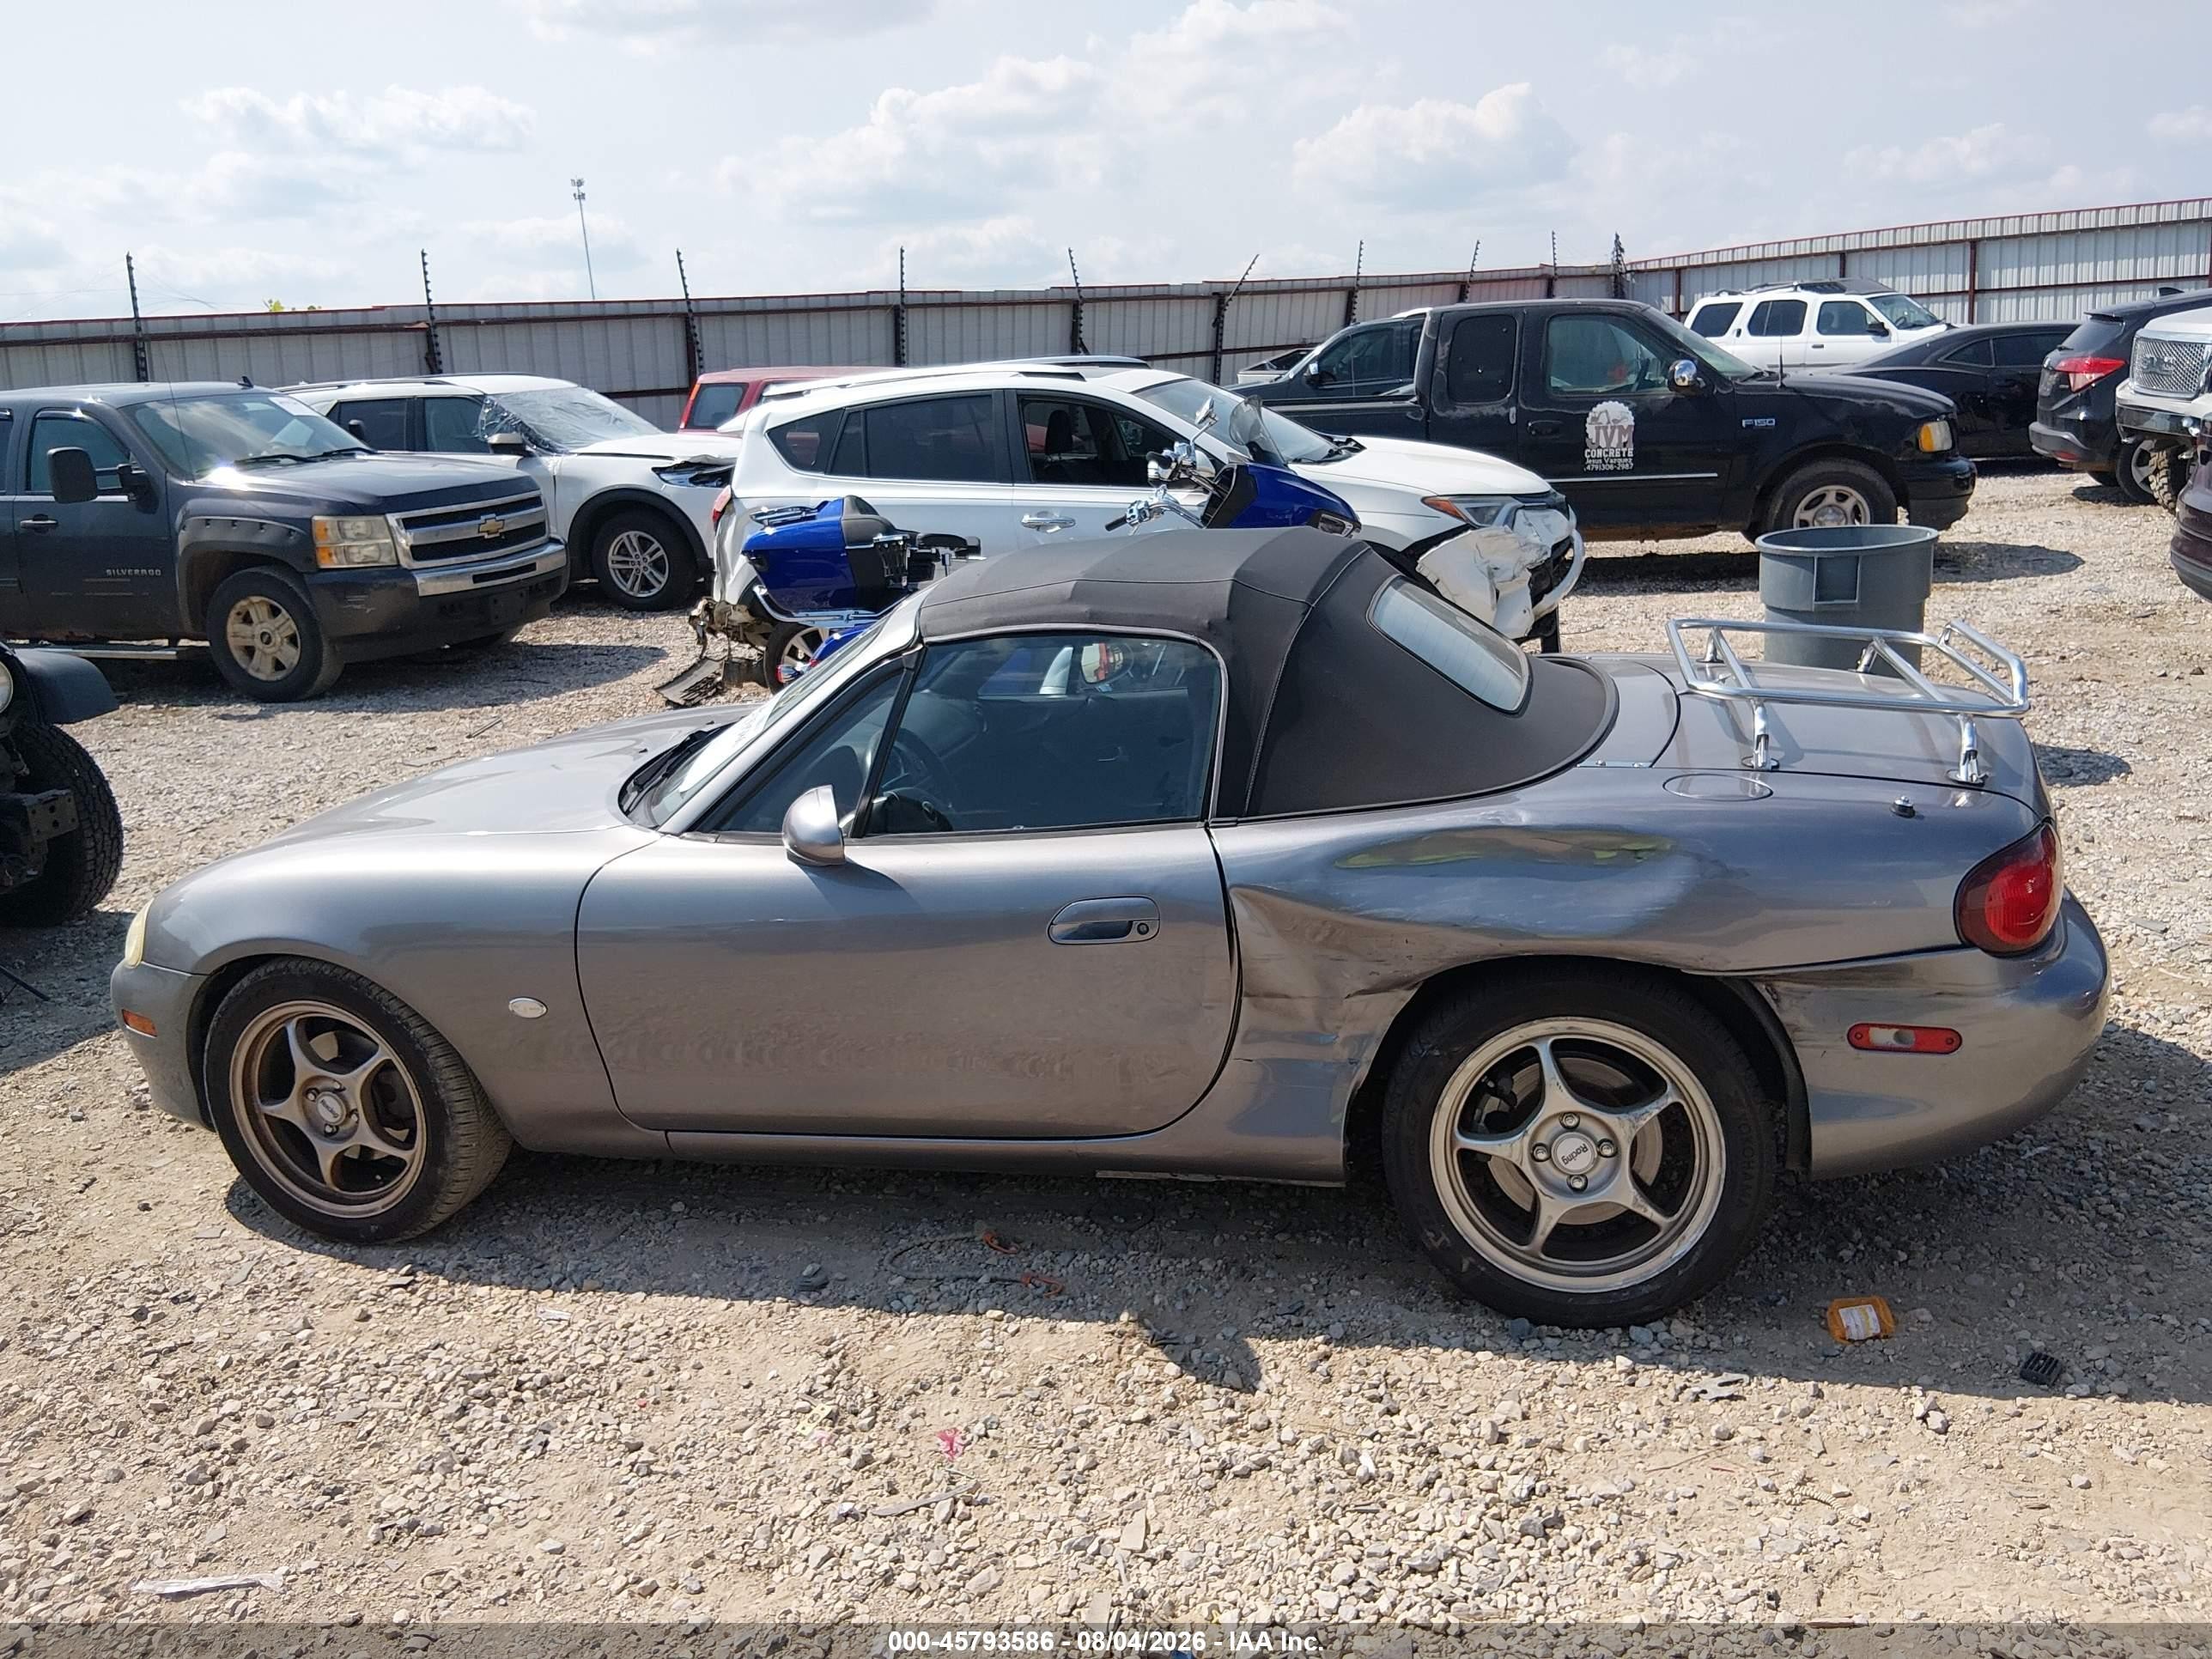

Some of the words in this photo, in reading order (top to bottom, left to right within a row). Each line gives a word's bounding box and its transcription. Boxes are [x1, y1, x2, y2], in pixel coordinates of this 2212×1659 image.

[1741, 418, 1776, 428] F150
[1585, 424, 1635, 450] JVM
[1584, 447, 1634, 459] CONCRETE
[106, 568, 162, 577] SILVERADO
[1561, 1143, 1589, 1165] Racing
